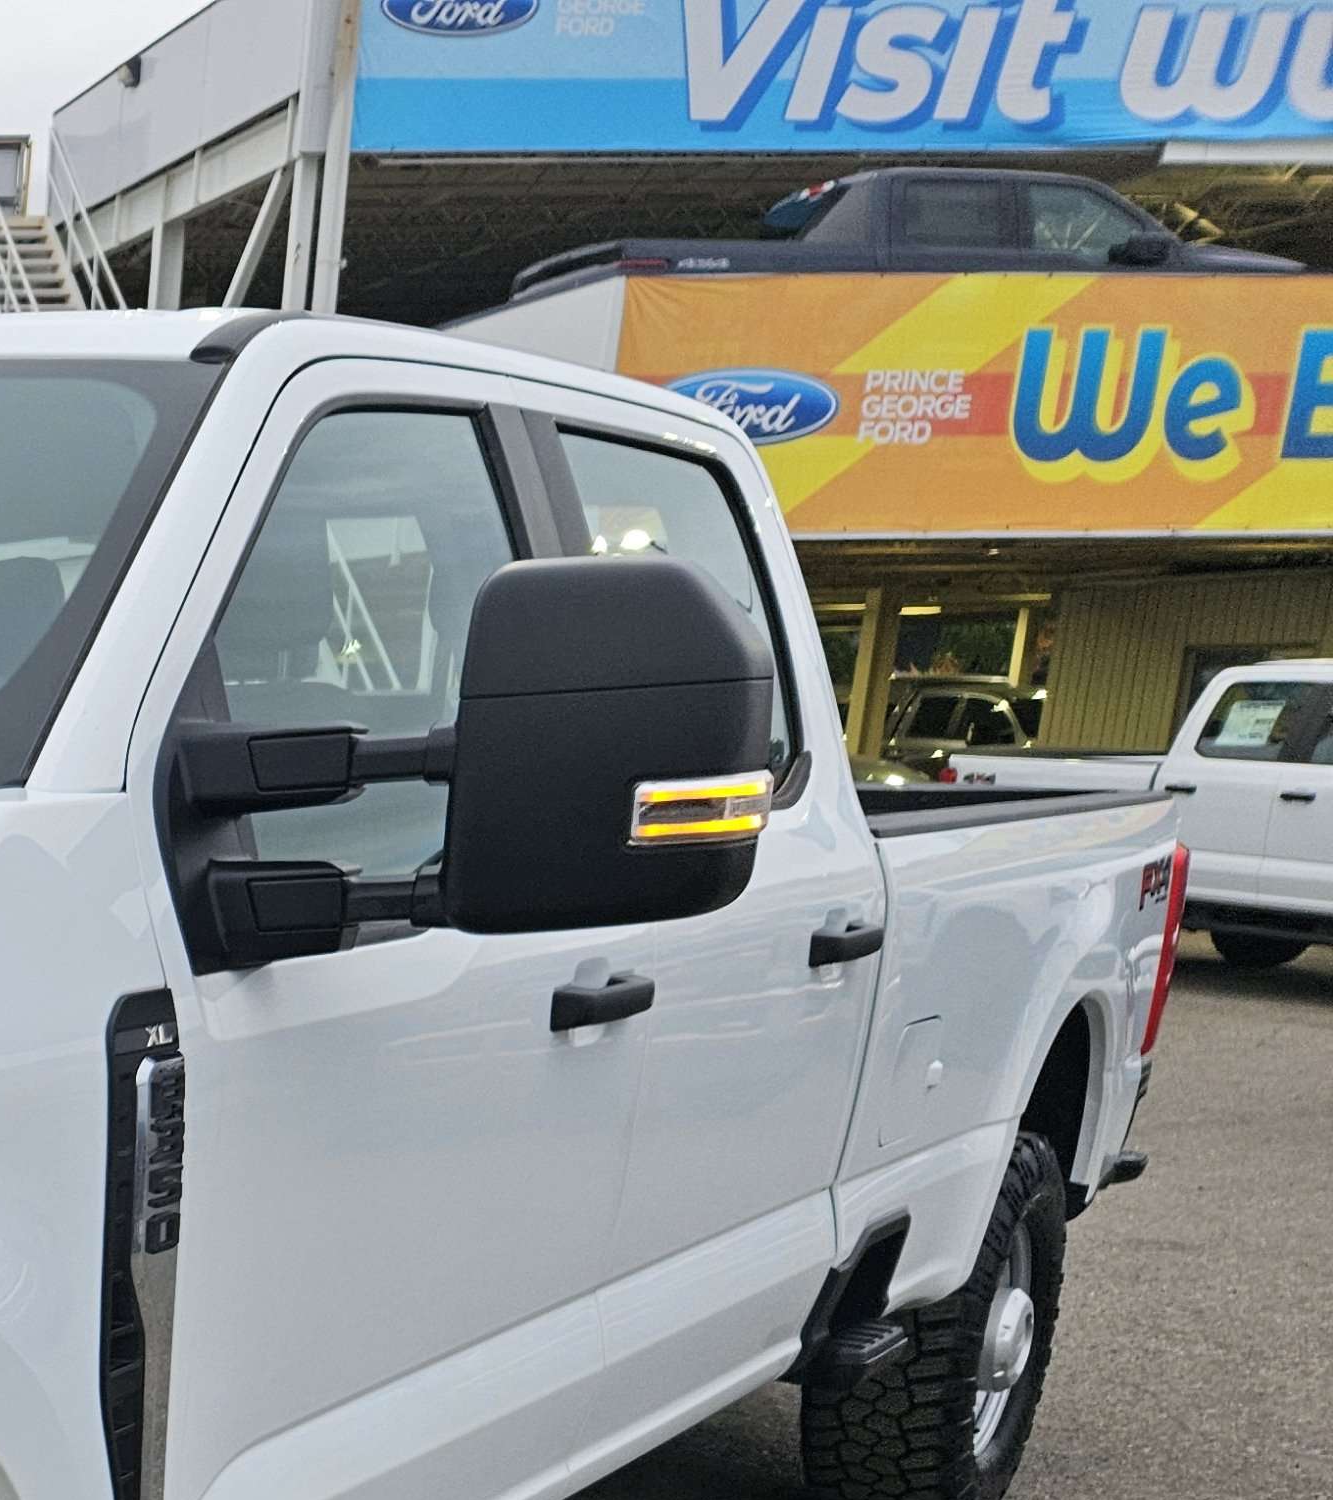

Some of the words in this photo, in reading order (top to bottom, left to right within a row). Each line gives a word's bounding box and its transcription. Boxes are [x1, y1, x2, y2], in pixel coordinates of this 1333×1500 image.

[556, 17, 614, 37] FORD
[679, 0, 1076, 125] Visit
[865, 370, 965, 393] PRINCE
[860, 395, 972, 419] GEORGE
[1013, 327, 1243, 463] We
[857, 422, 933, 445] FORD
[145, 1023, 174, 1048] XL
